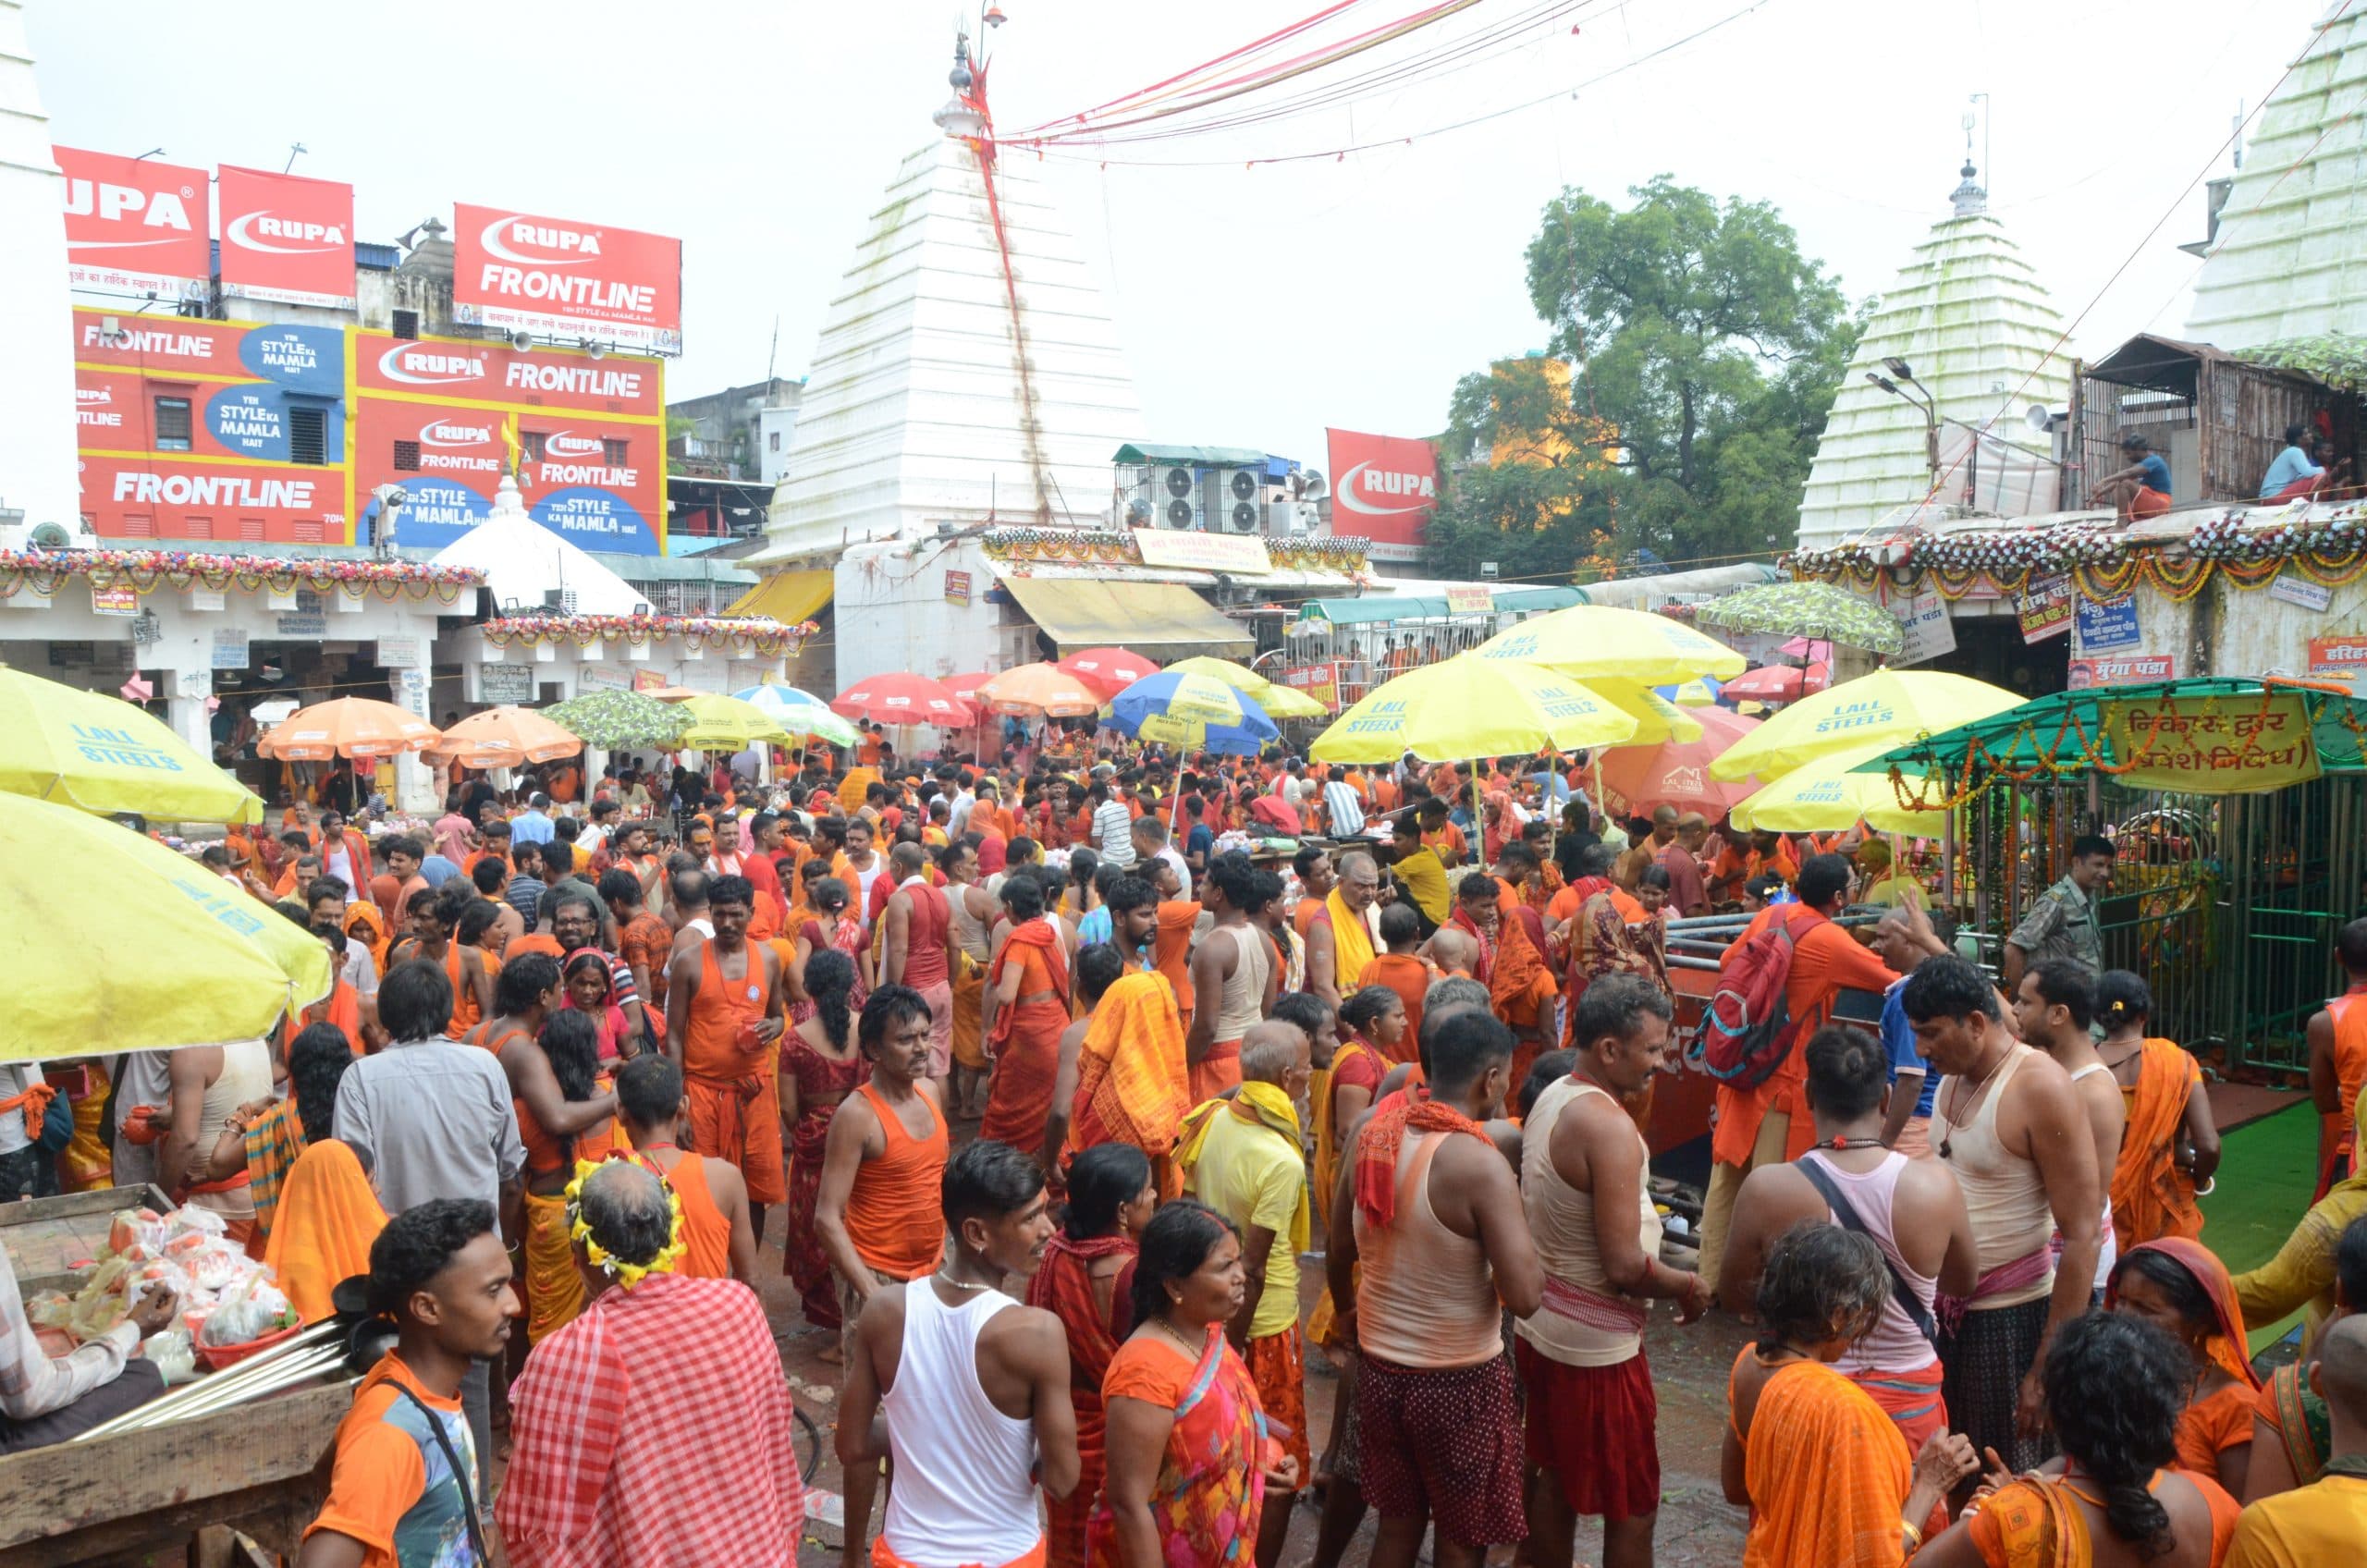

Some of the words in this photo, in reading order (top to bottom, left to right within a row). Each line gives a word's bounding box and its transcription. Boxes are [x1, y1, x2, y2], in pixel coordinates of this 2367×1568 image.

[63, 176, 192, 231] UPA
[258, 216, 346, 245] RUPA
[513, 222, 601, 256] RUPA
[480, 263, 656, 313] FRONTLINE
[83, 325, 214, 358] FRONTLINE
[261, 340, 305, 355] STYLE
[263, 353, 316, 369] MAMLA
[405, 353, 485, 378] RUPA
[506, 361, 641, 398] FRONTLINE
[77, 389, 112, 401] UPA
[242, 395, 259, 405] YEH
[220, 405, 266, 422] STYLE
[266, 413, 280, 423] KA
[220, 420, 281, 438] MAMLA
[435, 424, 491, 443] RUPA
[559, 436, 604, 452] RUPA
[420, 454, 499, 472] FRONTLINE
[540, 463, 638, 488] FRONTLINE
[1364, 468, 1435, 498] RUPA
[113, 472, 316, 509] FRONTLINE
[420, 487, 466, 507] STYLE
[414, 506, 473, 526] MAMLA
[567, 497, 611, 515] STYLE
[547, 513, 561, 522] KA
[561, 514, 618, 533] MAMLA
[1370, 700, 1407, 714] LALL
[1834, 700, 1883, 716] LALL
[1346, 718, 1404, 733] STEELS
[1815, 711, 1894, 733] STEELS
[71, 723, 144, 746] LALL
[78, 744, 184, 772] STEELS
[1794, 790, 1843, 802] STEELS
